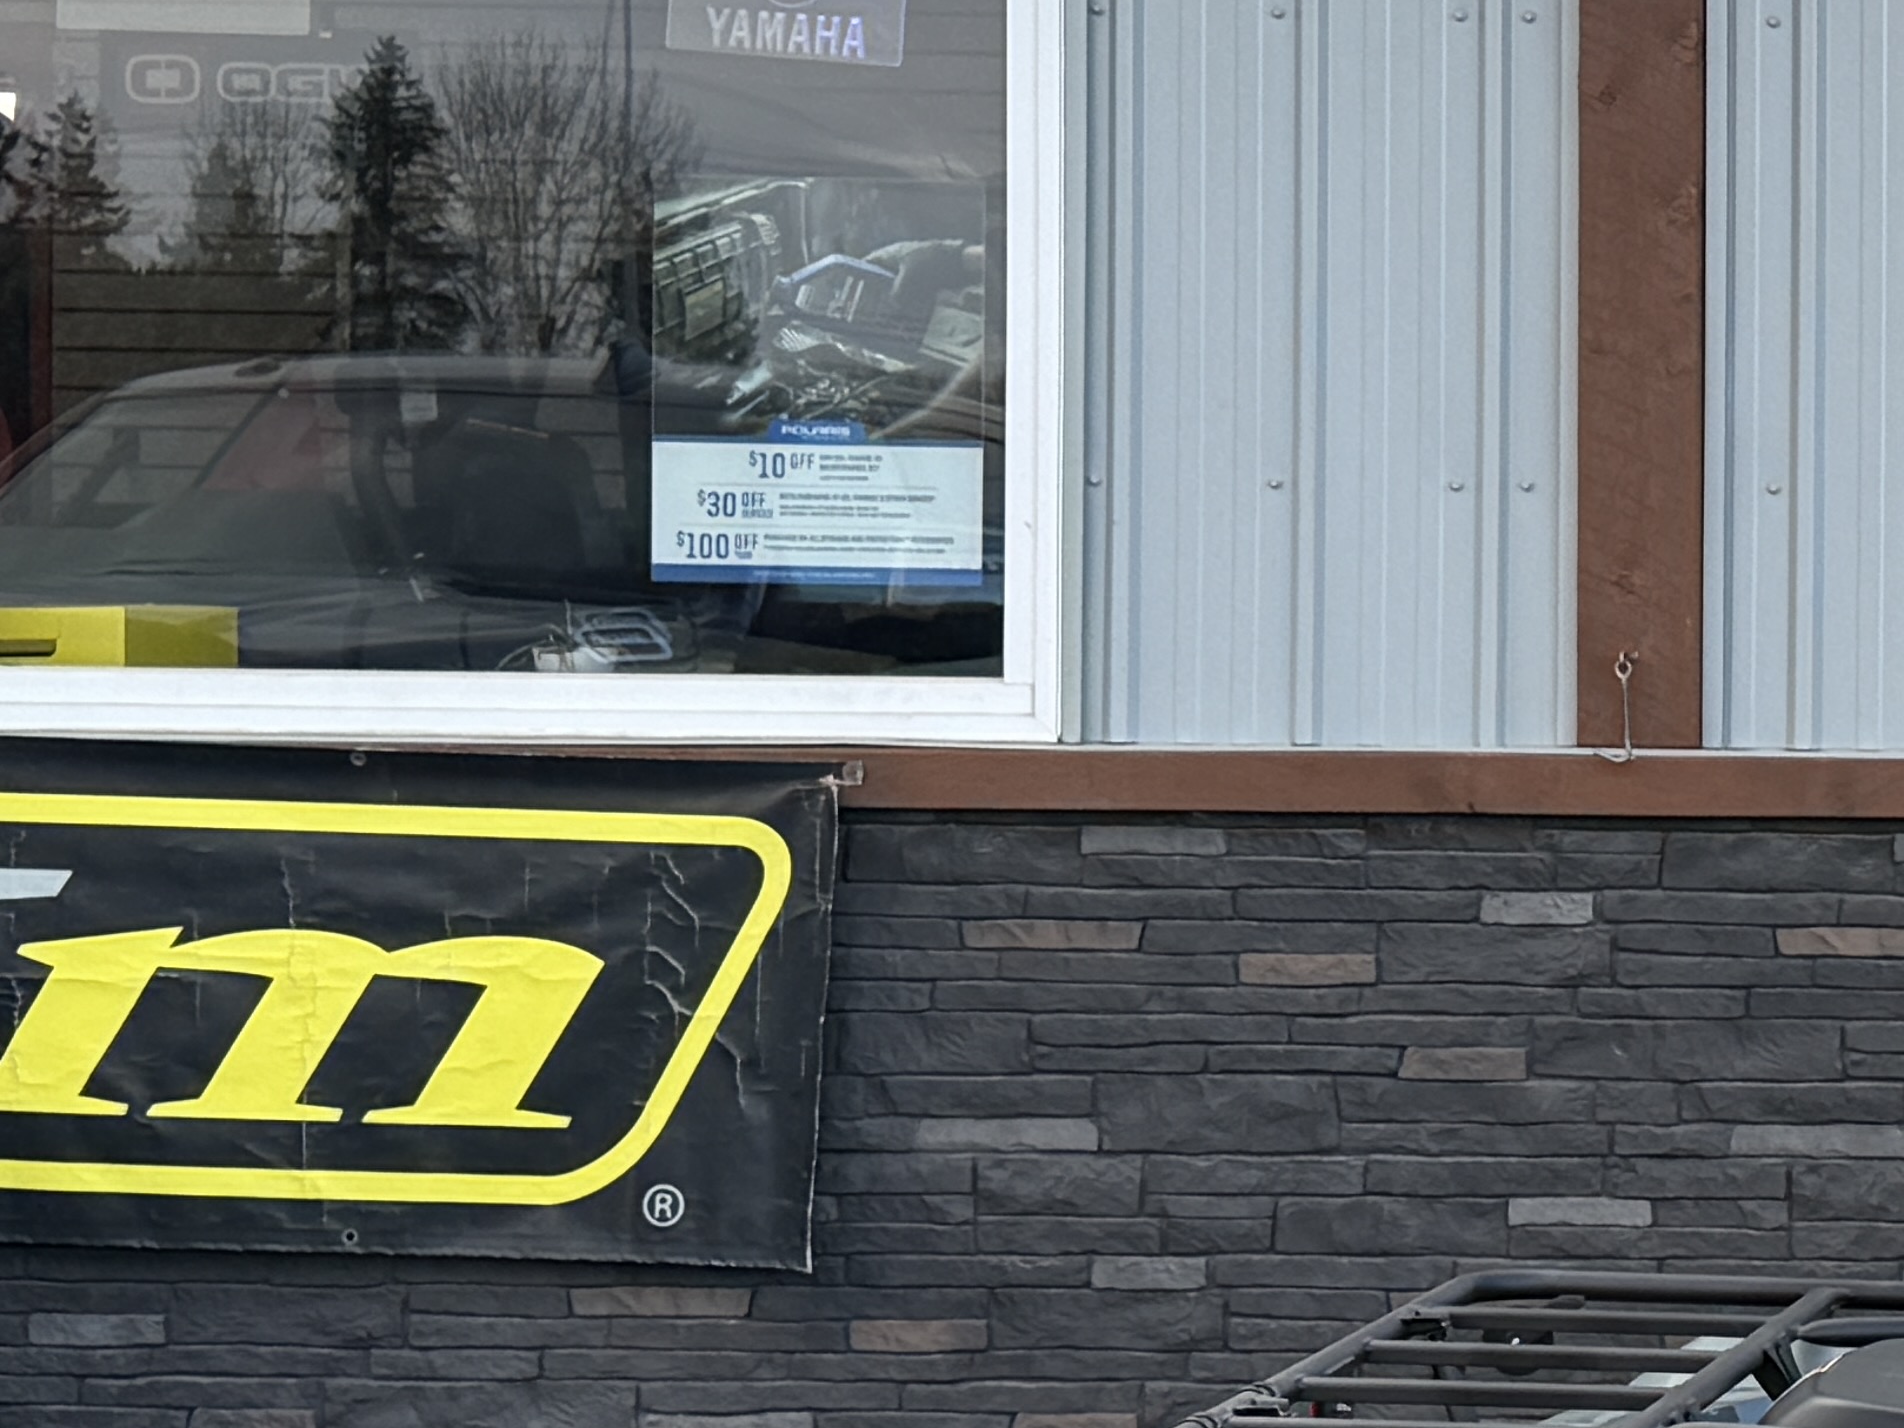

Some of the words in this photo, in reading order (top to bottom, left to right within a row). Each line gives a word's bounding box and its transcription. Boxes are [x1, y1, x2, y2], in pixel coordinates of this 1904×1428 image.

[706, 3, 866, 60] YAMAHA
[749, 450, 786, 479] $10
[790, 452, 815, 470] OFF
[697, 489, 737, 518] $30
[741, 492, 765, 507] OFF
[677, 531, 730, 559] $100
[734, 533, 758, 549] OFF
